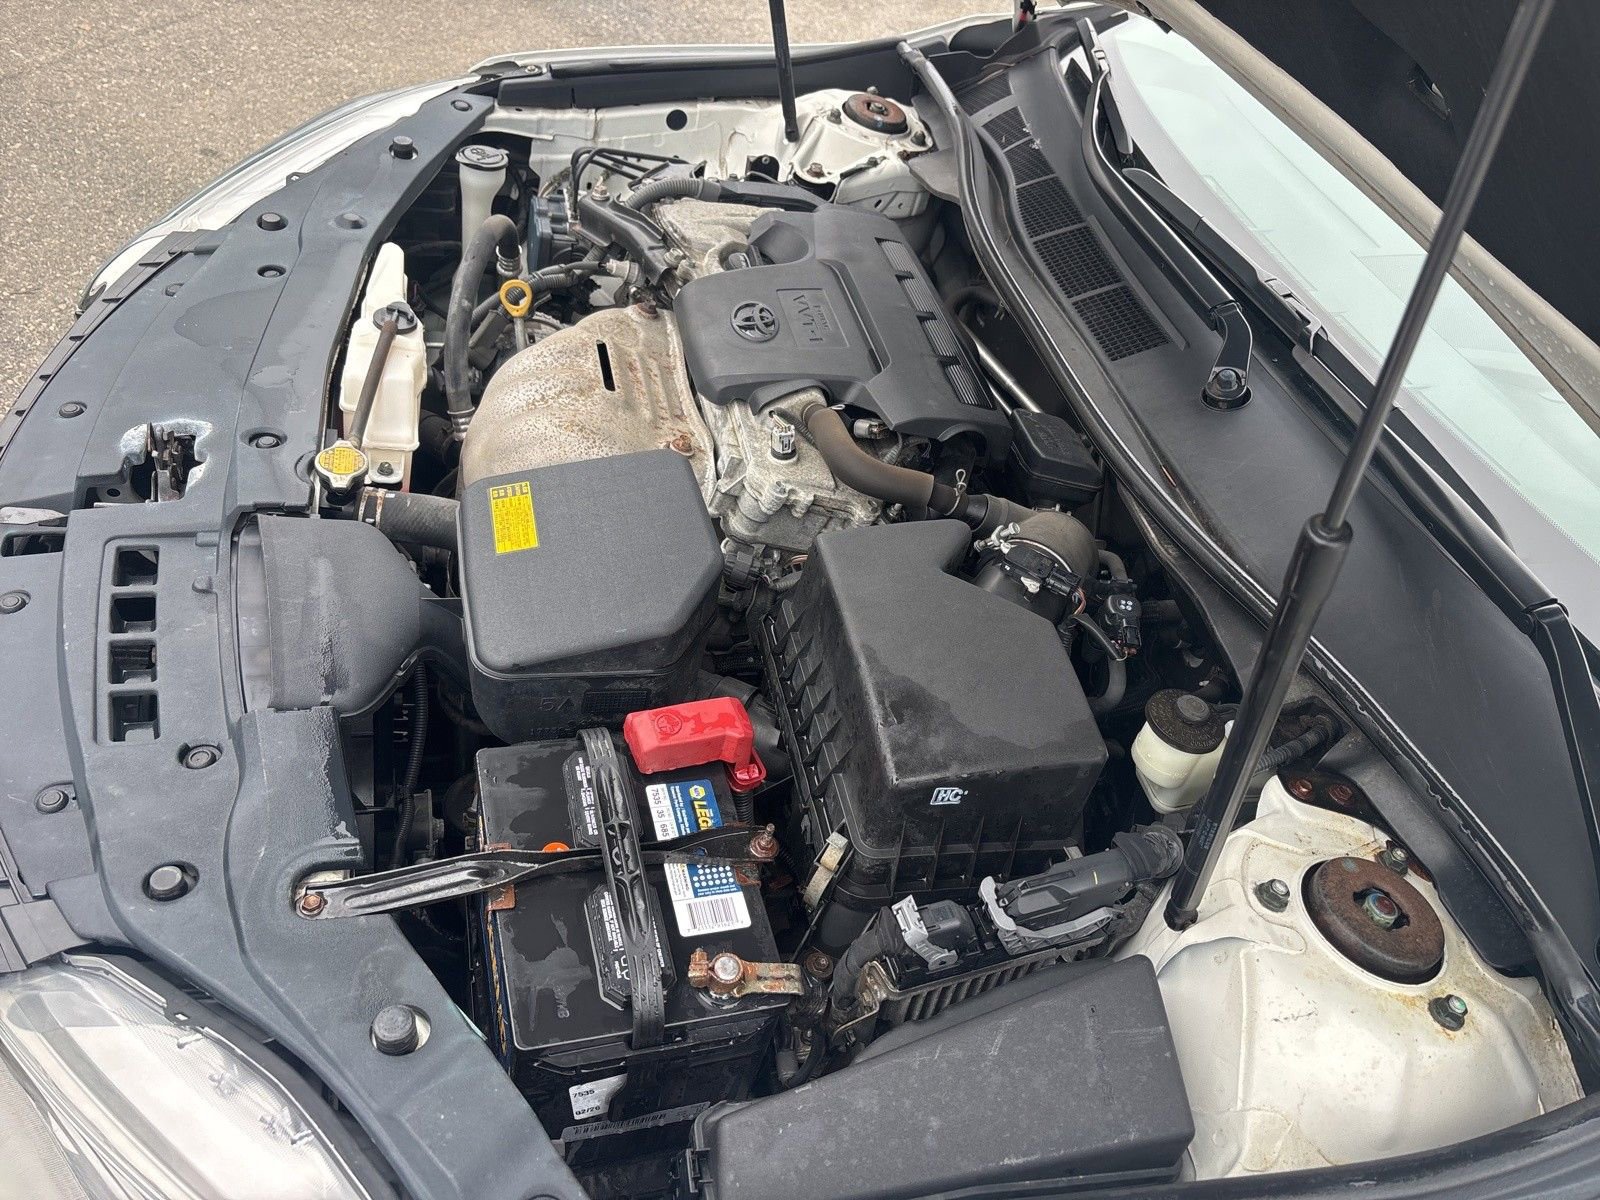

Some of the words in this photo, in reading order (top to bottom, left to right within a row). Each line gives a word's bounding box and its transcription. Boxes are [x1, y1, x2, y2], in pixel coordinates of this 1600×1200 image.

[651, 787, 662, 805] 7535
[656, 809, 666, 819] 35
[660, 823, 670, 838] 685
[572, 1089, 595, 1098] 7535
